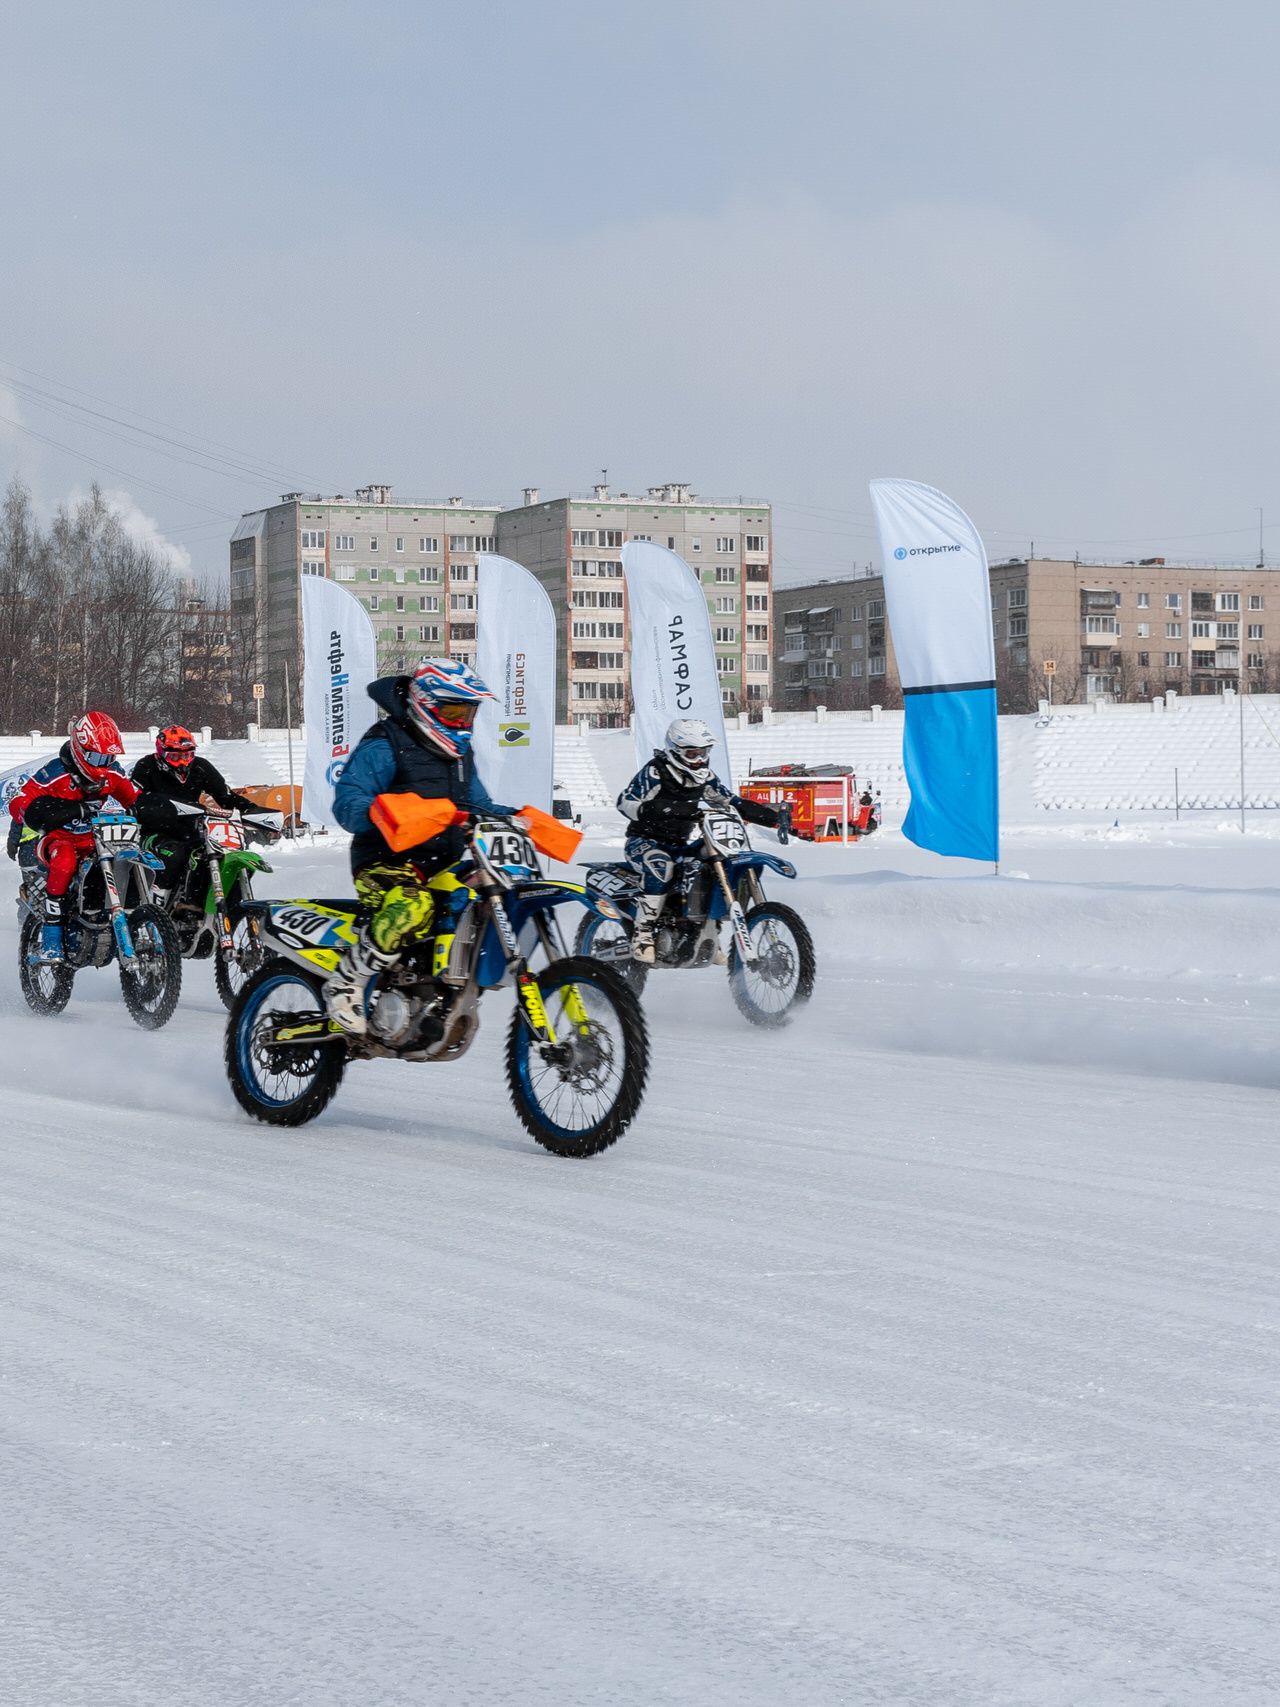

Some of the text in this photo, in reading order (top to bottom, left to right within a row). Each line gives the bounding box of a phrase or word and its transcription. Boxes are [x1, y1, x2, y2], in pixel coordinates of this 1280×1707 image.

[909, 543, 961, 556] открытие
[255, 685, 263, 693] 12
[757, 791, 793, 801] АЦ 2
[101, 825, 137, 842] 117
[489, 834, 537, 869] 430
[586, 870, 627, 897] 212
[278, 908, 331, 936] 430
